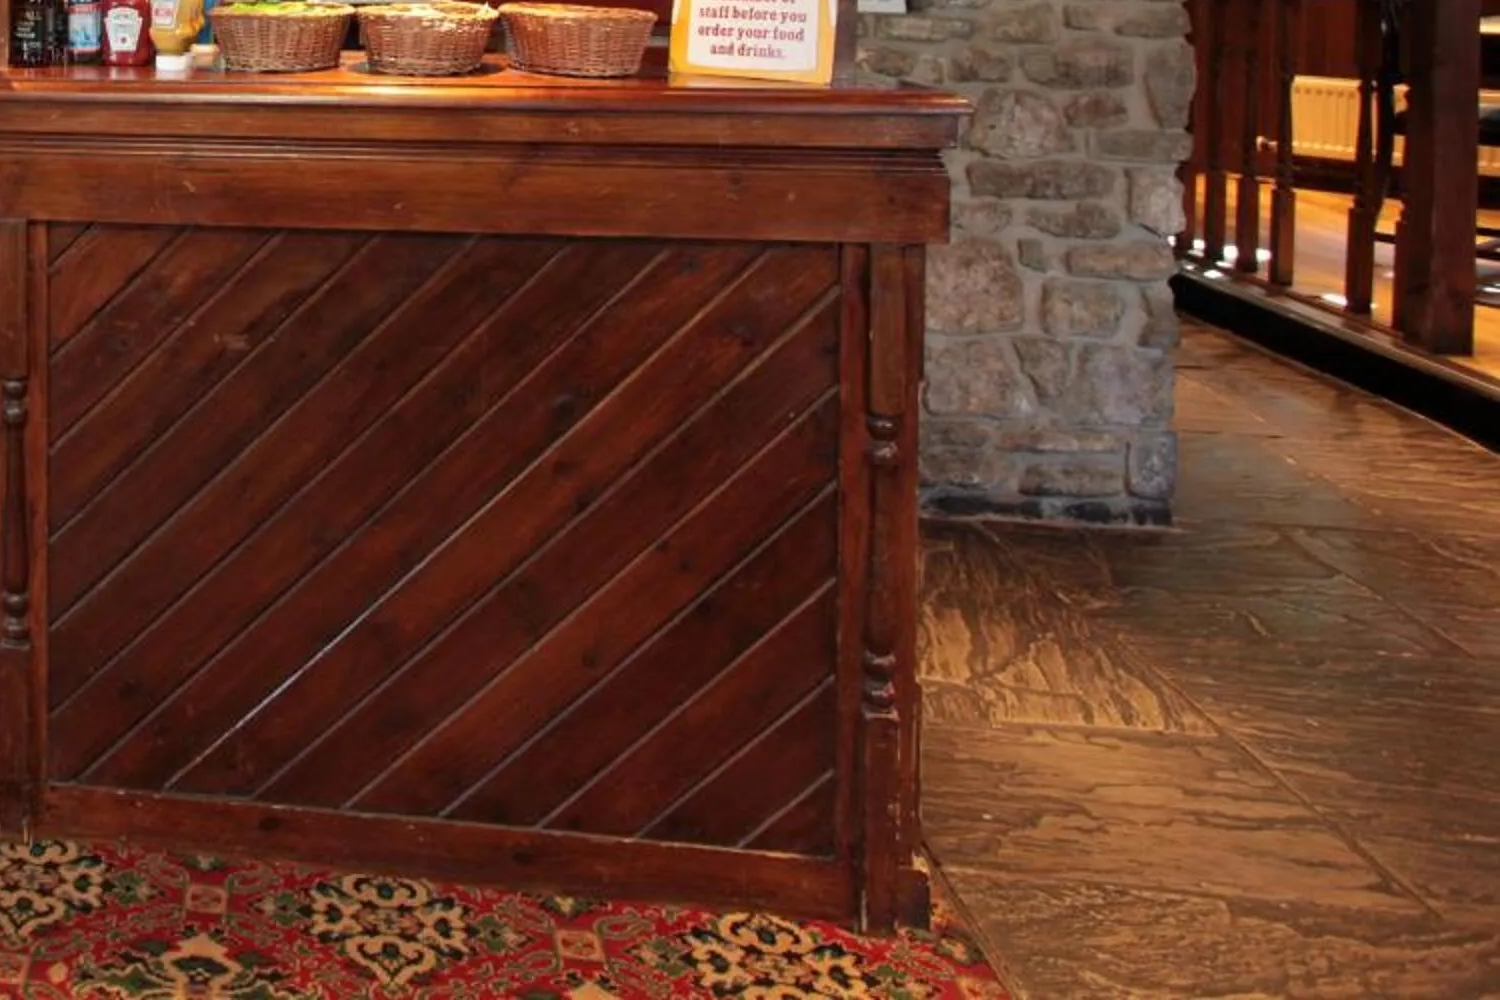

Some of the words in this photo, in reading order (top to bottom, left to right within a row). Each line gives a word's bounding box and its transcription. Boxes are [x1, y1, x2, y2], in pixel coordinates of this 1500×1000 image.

[700, 5, 729, 19] staff
[732, 5, 778, 21] before
[780, 11, 807, 24] you
[698, 24, 734, 37] order
[737, 27, 769, 40] your
[773, 27, 805, 41] food
[710, 43, 734, 55] and
